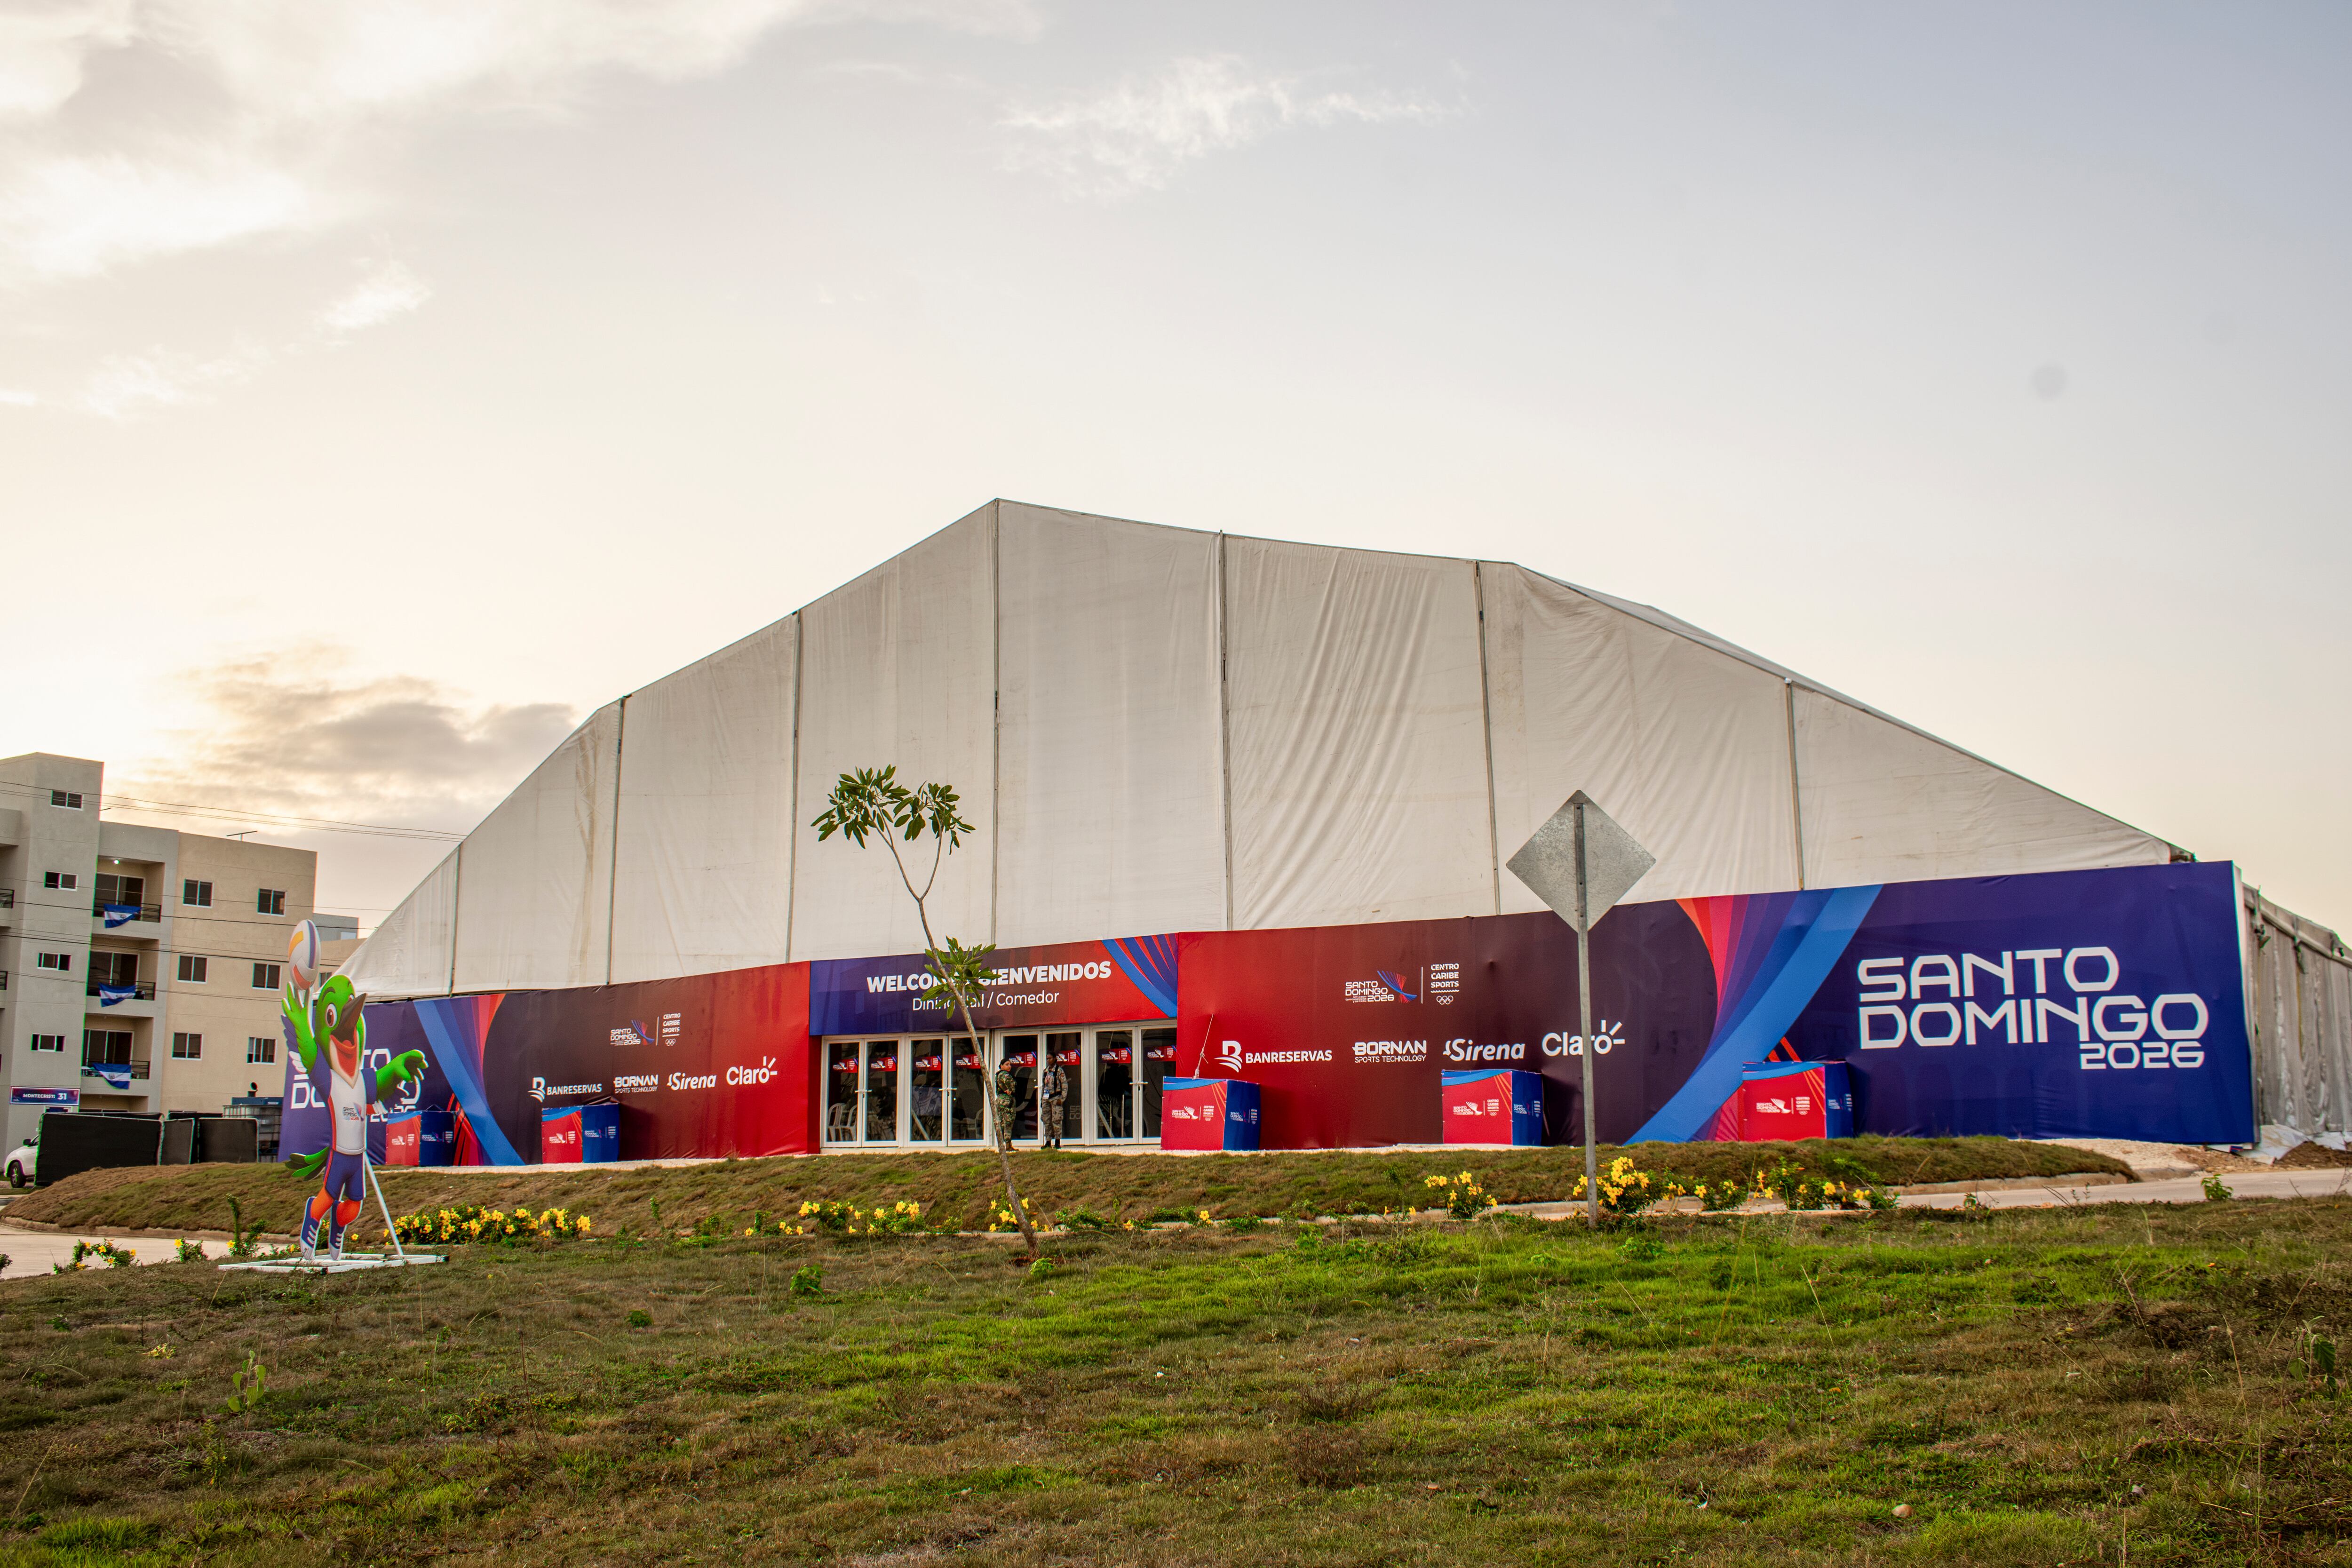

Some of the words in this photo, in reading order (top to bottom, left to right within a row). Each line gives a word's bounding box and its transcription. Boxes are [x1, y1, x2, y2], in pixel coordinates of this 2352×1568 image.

[866, 970, 961, 993] WELCO
[1858, 946, 2120, 1002] SANTO
[996, 990, 1059, 1006] Comedor
[1345, 987, 1388, 996] DOMINGO
[1859, 993, 2209, 1050] DOMINGO
[1352, 1040, 1427, 1055] BORNAN
[1449, 1038, 1526, 1061] Sirena
[1542, 1032, 1613, 1057] Clao
[1246, 1050, 1332, 1064] BANRESERVAS
[1381, 1054, 1427, 1063] TECHNOLOGY
[2079, 1041, 2205, 1070] 2026
[613, 1074, 659, 1088] BORNAN
[670, 1072, 717, 1090] Sirena
[726, 1066, 770, 1085] Claro
[547, 1083, 602, 1095] BANRESERVAS
